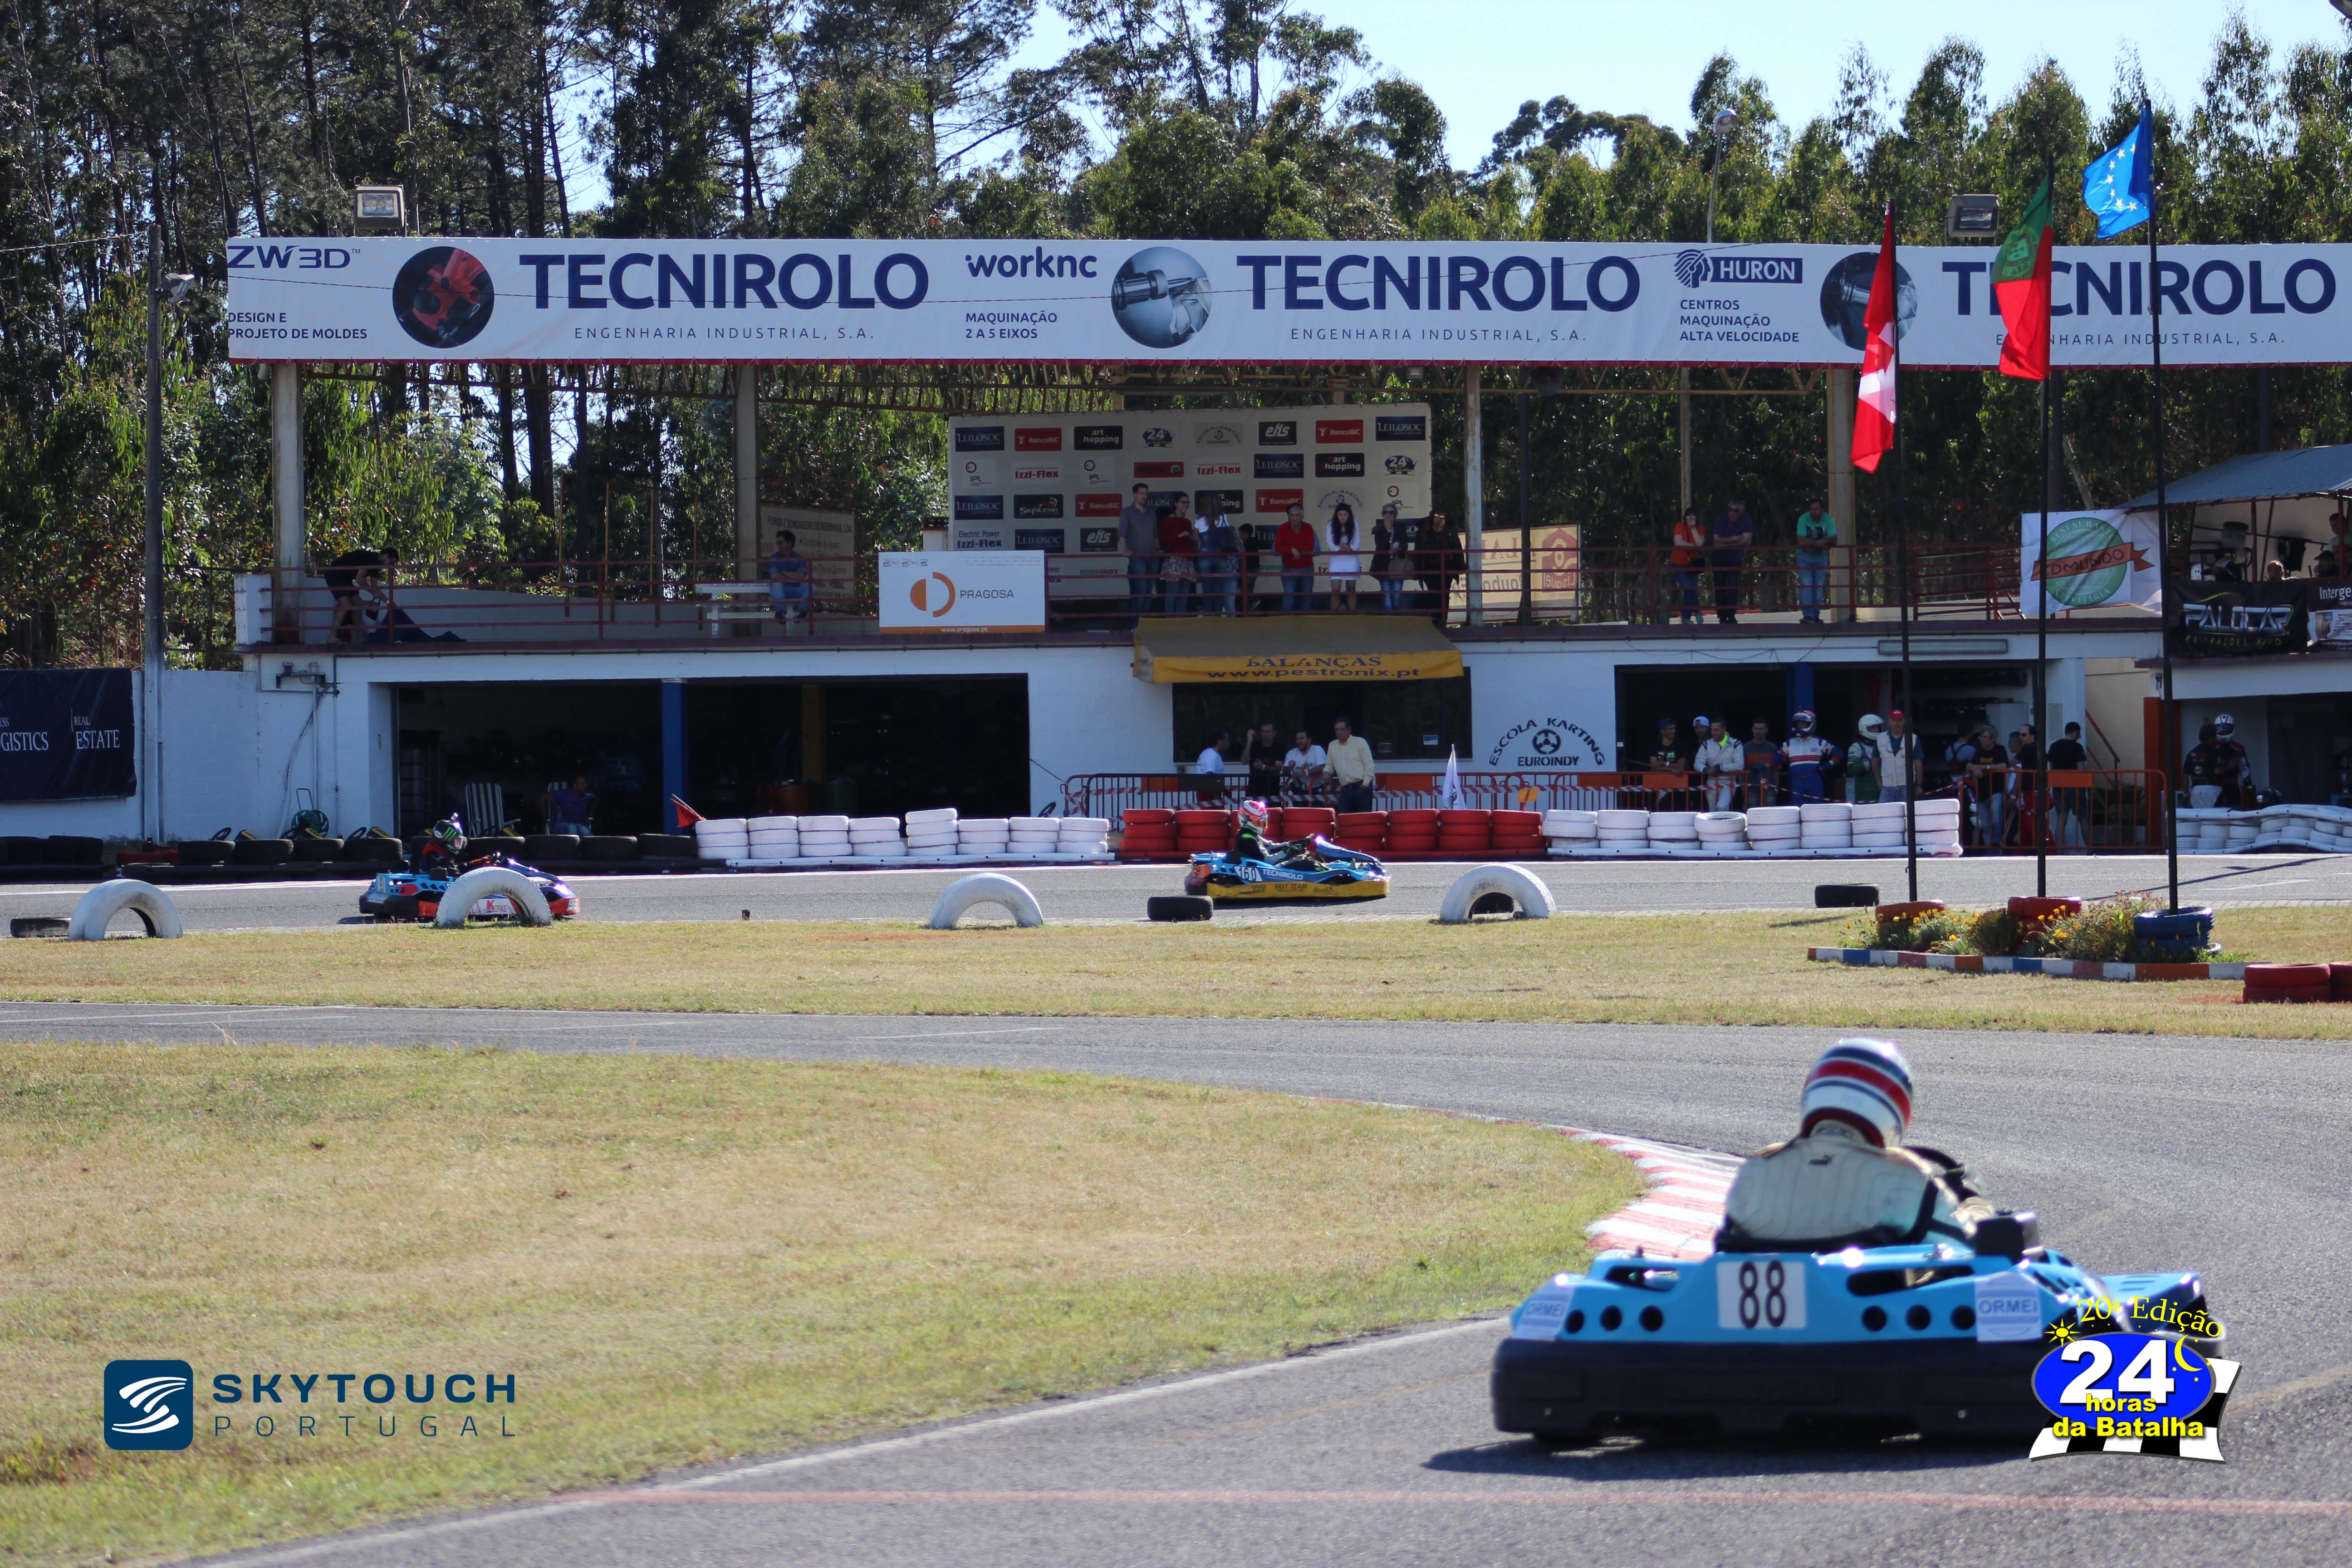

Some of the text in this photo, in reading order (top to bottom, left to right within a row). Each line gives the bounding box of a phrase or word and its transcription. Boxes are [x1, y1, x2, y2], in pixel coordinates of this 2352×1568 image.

[228, 245, 350, 269] ZW3D
[1720, 260, 1795, 280] HURON
[519, 252, 929, 310] TECNIROLO
[1236, 254, 1640, 312] TECNIROLO
[1942, 259, 2336, 315] TCNIROLO
[1681, 299, 1740, 310] CENTROS
[228, 312, 286, 323] DESIGN E
[965, 310, 1058, 326] MAQUINAÇÃO
[1680, 314, 1770, 328] MAQUINAÇÃO
[228, 328, 367, 339] PROJETO DE MOLDES
[575, 328, 874, 341] ENGENHARIA INDUSTRIAL, S.A.
[965, 328, 1038, 338] 2 A 5 EIXOS
[1291, 328, 1586, 343] ENGENHARIA INDUSTRIAL, S.A.
[1680, 331, 1799, 343] ALTA VELOCIDADE
[1996, 333, 2114, 345] ENHARIA
[2249, 333, 2285, 343] S.A.
[1377, 422, 1423, 432] LEILOSOC
[956, 433, 1001, 443] LEILOSOC
[1147, 429, 1165, 440] 24
[1256, 459, 1301, 469] LEILOSOC
[1389, 457, 1406, 467] 24
[1015, 470, 1059, 479] Izzi-Flex
[1197, 466, 1241, 475] Izzi-Flex
[956, 501, 1001, 511] LEILOSOC
[957, 539, 1002, 549] Izzi-Flex
[1016, 535, 1061, 544] LEILOSOC
[960, 589, 1014, 599] PRAGOSA
[2319, 586, 2352, 601] Interge
[1207, 668, 1420, 678] www.pestronix.pt
[74, 716, 91, 725] REAL
[0, 732, 49, 751] GISTICS
[76, 730, 120, 749] ESTATE
[1489, 717, 1605, 766] ESCOLA KARTING
[1518, 756, 1579, 766] EUROINDY
[1262, 868, 1303, 880] TECNIROLO
[1739, 1260, 1786, 1328] 88
[1979, 1299, 2037, 1314] ORMEI
